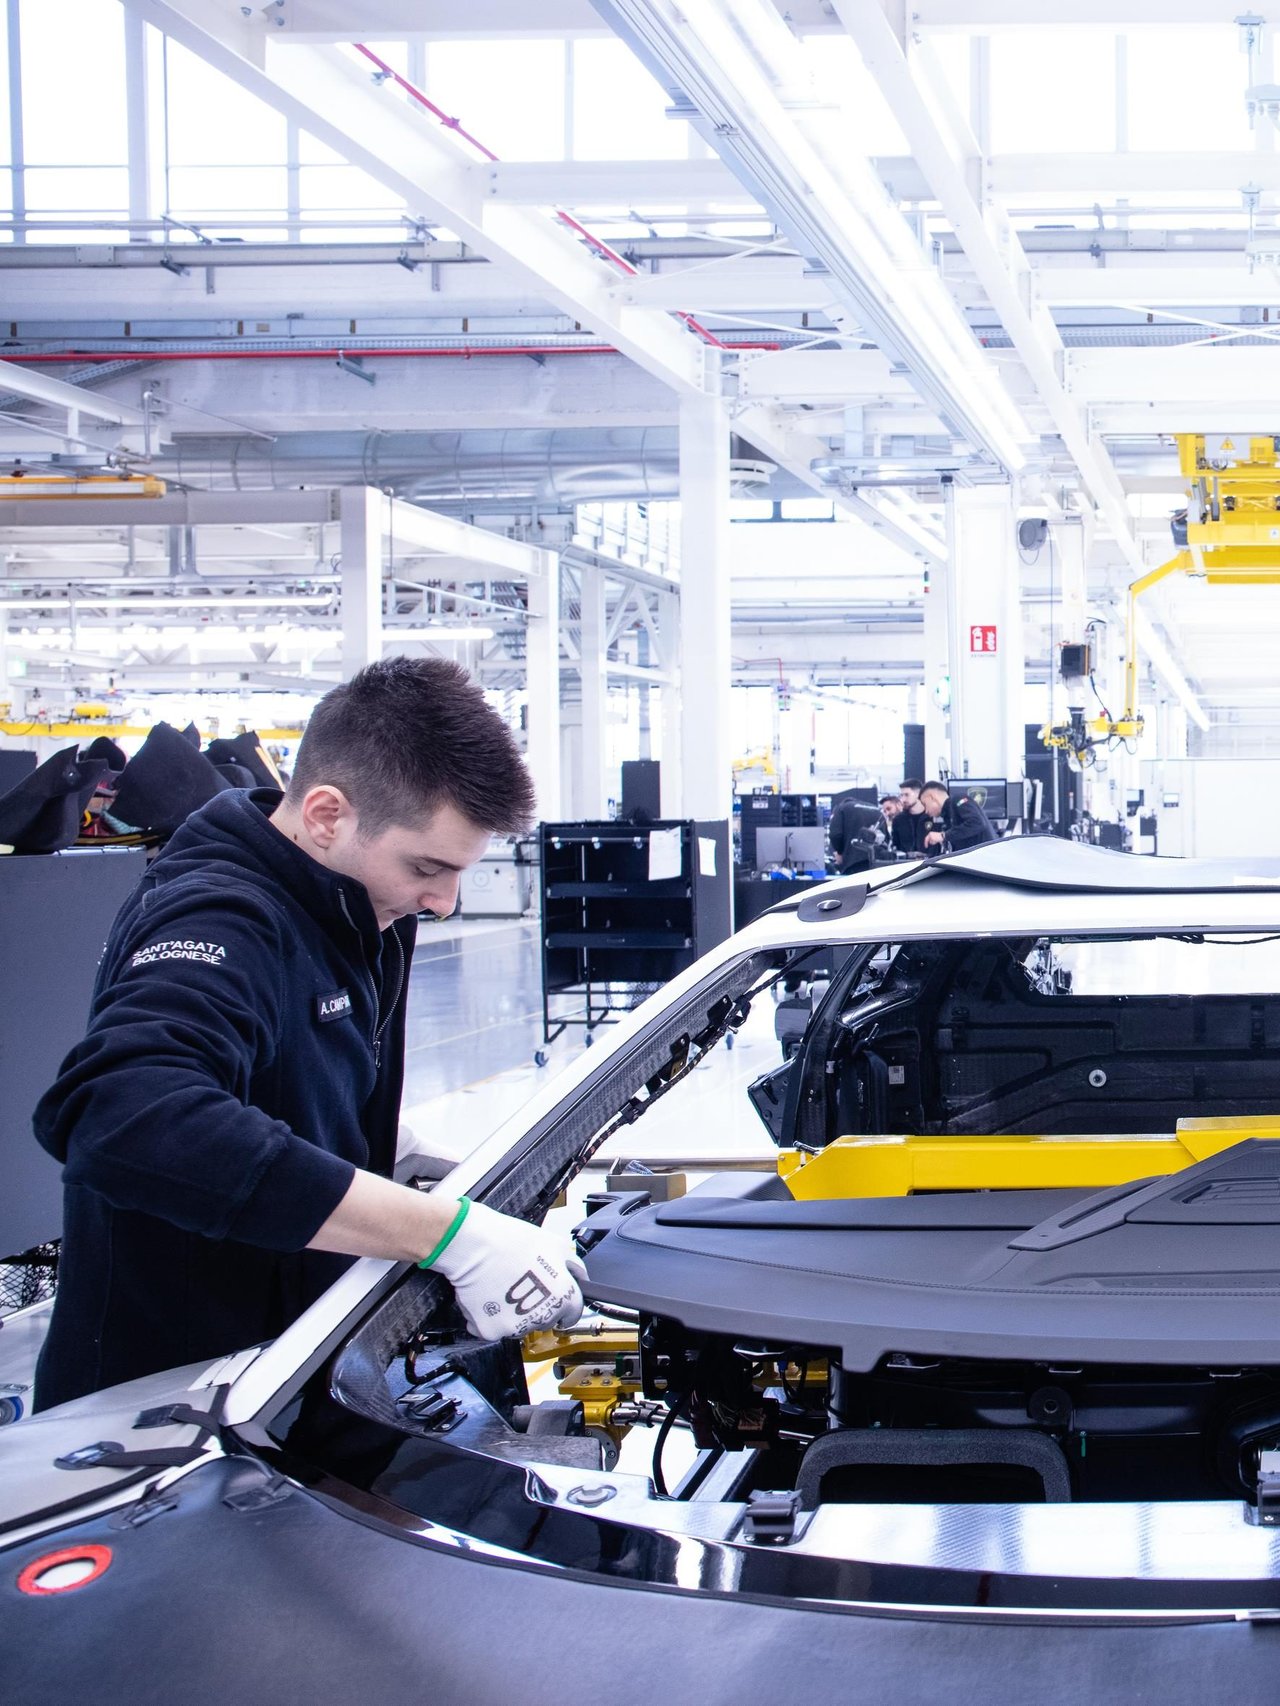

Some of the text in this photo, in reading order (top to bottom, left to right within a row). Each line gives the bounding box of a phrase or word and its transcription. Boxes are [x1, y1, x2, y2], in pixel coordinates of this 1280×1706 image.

[132, 940, 226, 959] SANT'AGATA
[132, 950, 221, 967] BOLOGNESE
[505, 1269, 552, 1315] B
